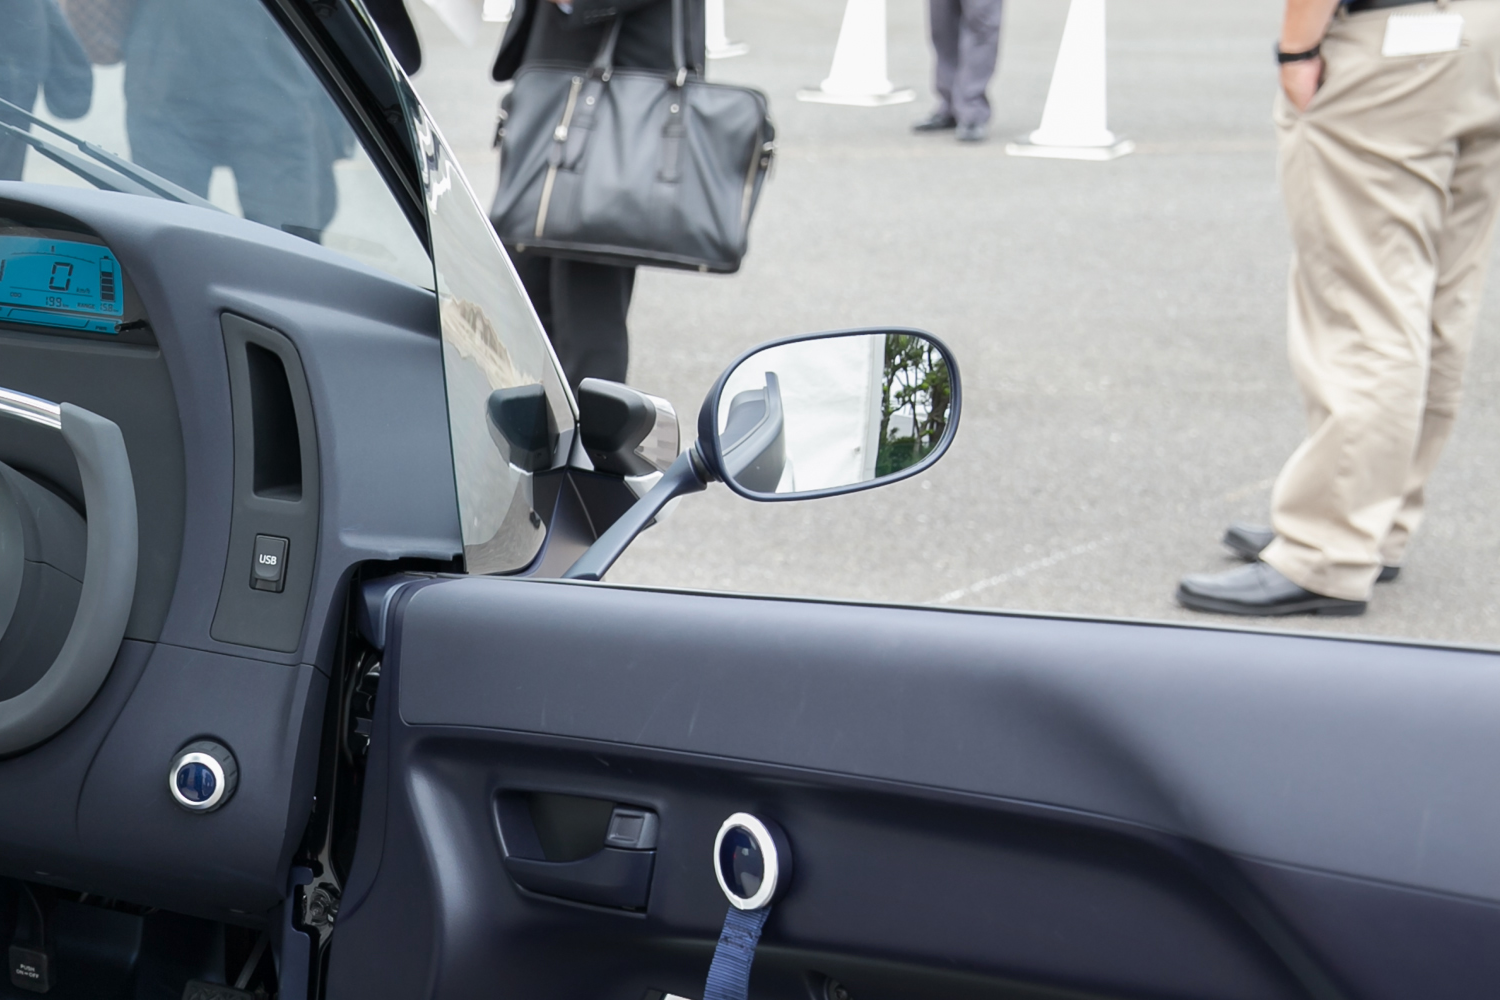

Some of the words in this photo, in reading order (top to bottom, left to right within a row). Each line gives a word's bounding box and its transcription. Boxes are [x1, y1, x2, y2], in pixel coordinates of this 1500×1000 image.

[49, 261, 74, 292] 0
[46, 296, 62, 307] 199
[259, 553, 277, 566] USB
[20, 963, 35, 972] PUSH
